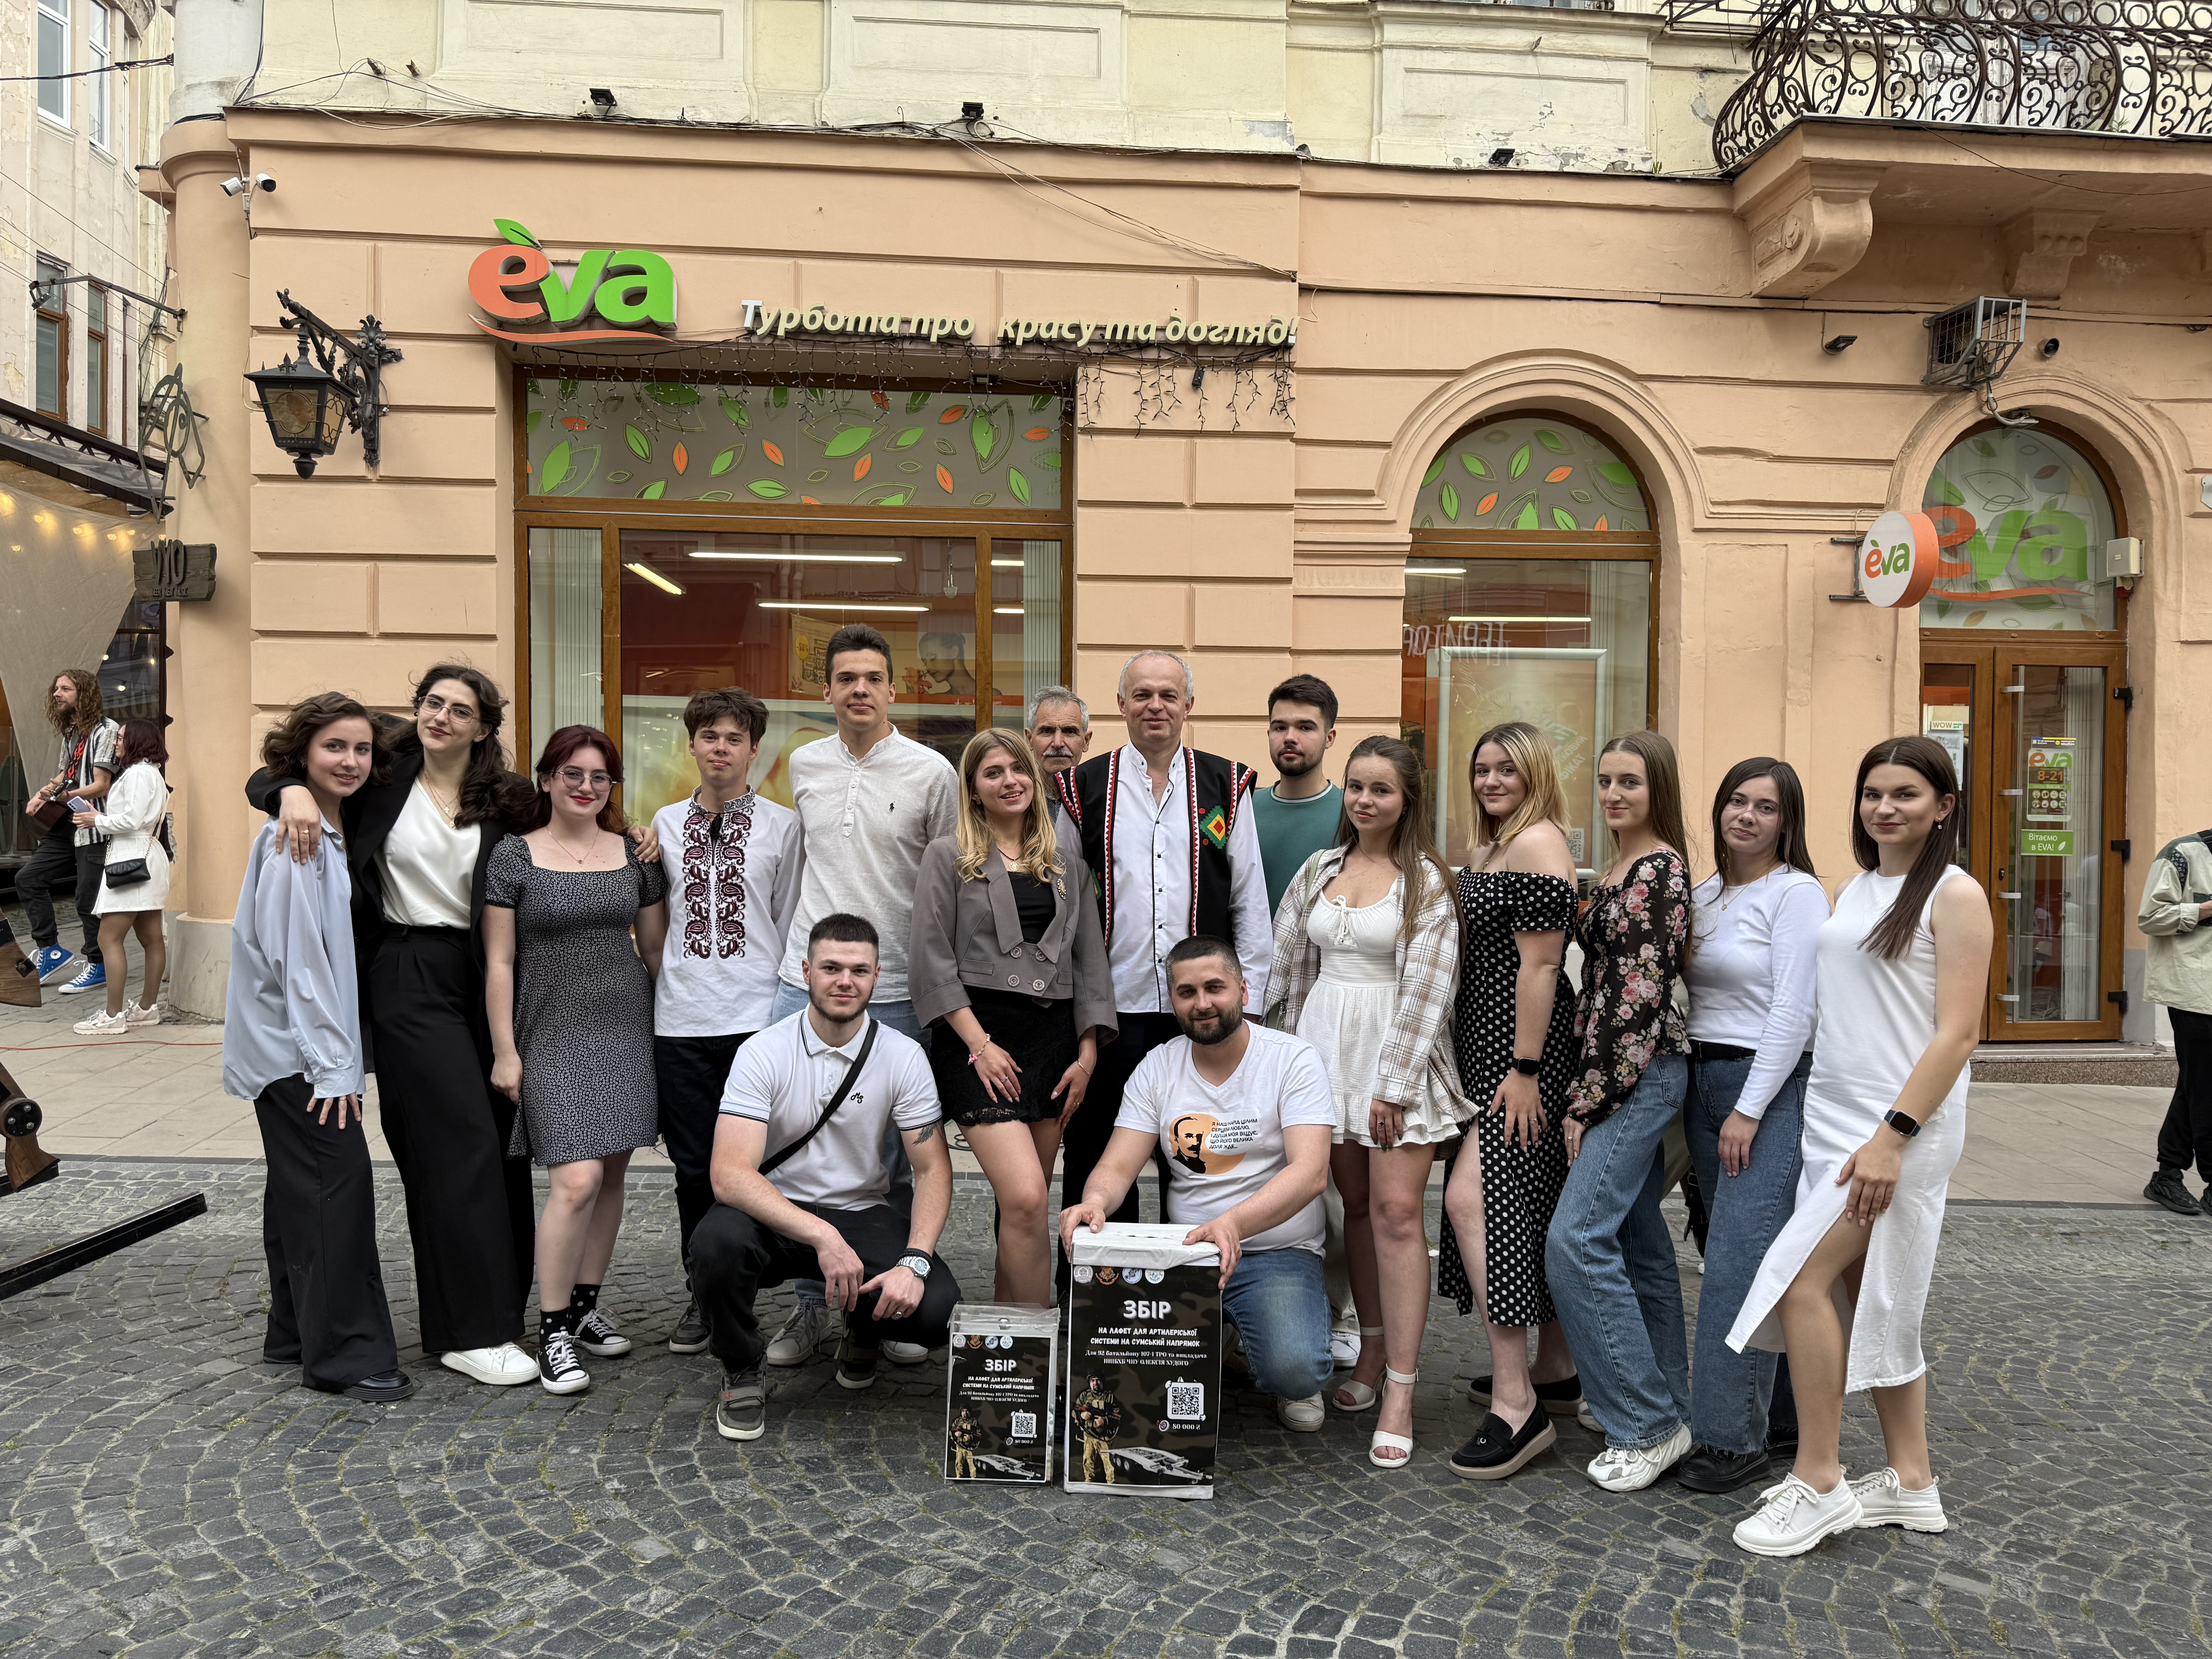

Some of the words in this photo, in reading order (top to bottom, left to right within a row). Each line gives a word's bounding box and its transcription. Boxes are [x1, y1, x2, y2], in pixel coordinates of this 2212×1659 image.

[741, 300, 902, 340] Турбота
[907, 313, 975, 345] про
[997, 317, 1098, 349] красу
[1104, 318, 1158, 344] та
[1165, 312, 1300, 348] догляд!
[2038, 771, 2064, 781] 8-21
[2029, 833, 2057, 841] Вітаємо
[1123, 1300, 1172, 1320] ЗБІР
[1149, 1328, 1198, 1336] АРТИЛЕРІСЬКОЇ
[1131, 1338, 1164, 1346] СУМСЬКИЙ
[985, 1359, 1017, 1372] ЗБІР
